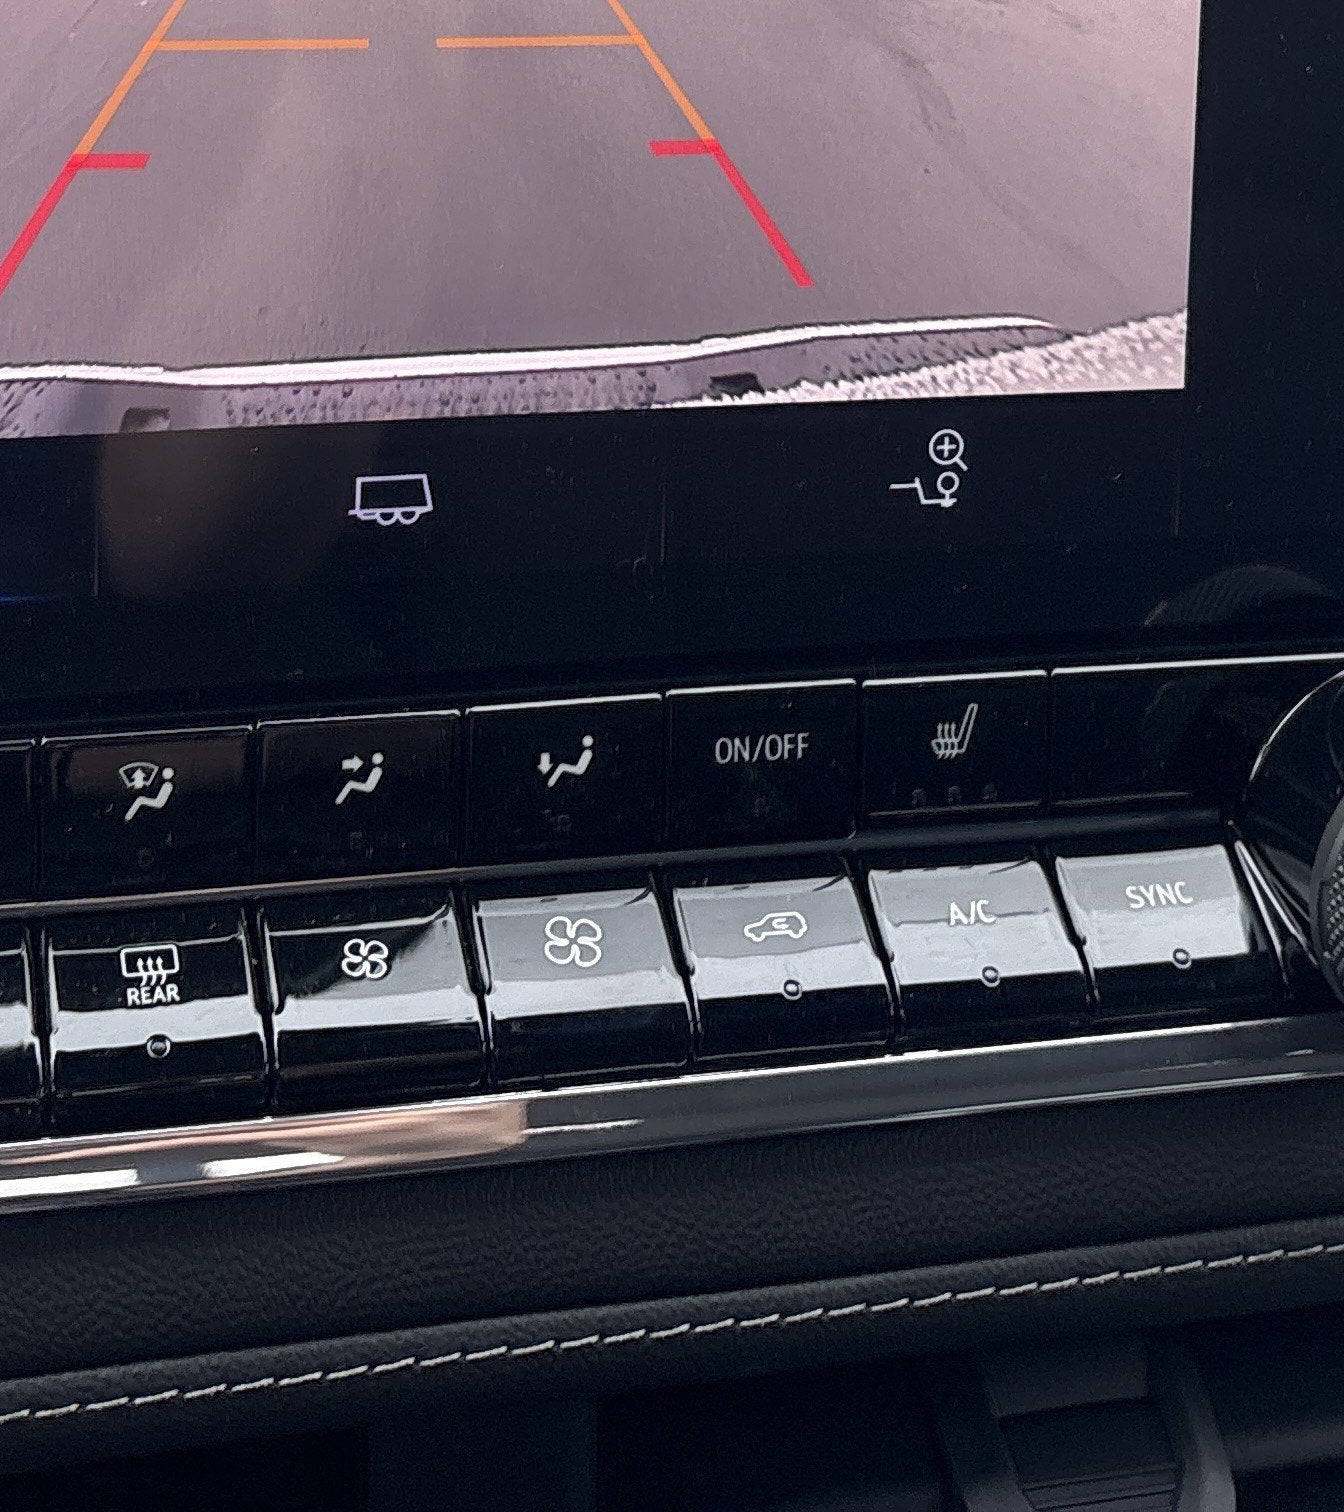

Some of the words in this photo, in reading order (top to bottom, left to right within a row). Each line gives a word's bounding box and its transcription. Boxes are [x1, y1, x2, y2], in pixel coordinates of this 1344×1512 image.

[714, 732, 811, 765] ON/OFF
[1125, 882, 1194, 909] SYNC
[949, 899, 997, 926] A/C
[126, 984, 181, 1006] REAR
